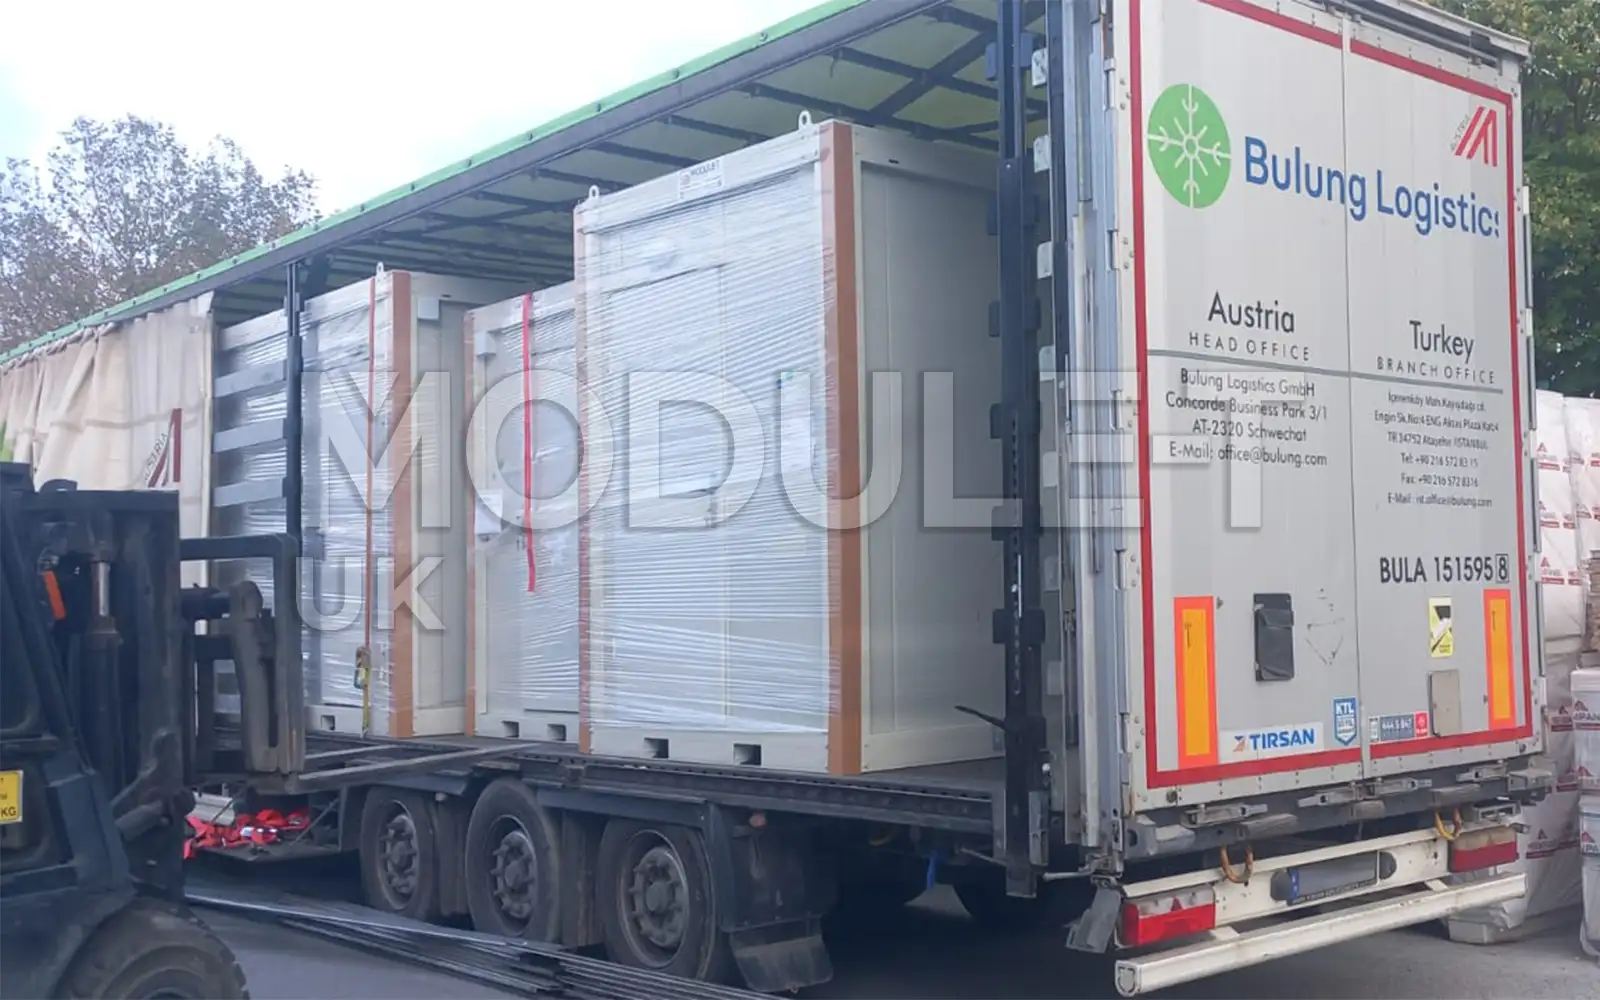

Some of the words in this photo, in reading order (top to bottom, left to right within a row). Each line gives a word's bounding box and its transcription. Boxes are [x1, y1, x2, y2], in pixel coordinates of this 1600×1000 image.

[1245, 136, 1366, 221] Bulung
[1208, 289, 1295, 334] Austria
[1189, 332, 1238, 352] HEAD
[1246, 339, 1310, 361] OFFICE
[1409, 319, 1475, 365] Turkey
[1180, 367, 1223, 391] Bulung
[1227, 374, 1276, 395] Logistics
[1279, 378, 1315, 397] GmbH
[1377, 356, 1438, 378] BRANCH
[1444, 365, 1495, 384] OFFICE
[1165, 391, 1226, 413] Concorde
[1229, 397, 1279, 417] Business
[1282, 402, 1305, 419] Park
[1309, 404, 1328, 422] 3/1
[1192, 418, 1244, 437] AT-2320
[1247, 422, 1307, 441] Schwechat
[1169, 440, 1214, 459] E-Mail:
[1217, 443, 1328, 468] office@bulung.com
[1380, 556, 1428, 584] BULA
[1249, 727, 1316, 751] TIRSAN
